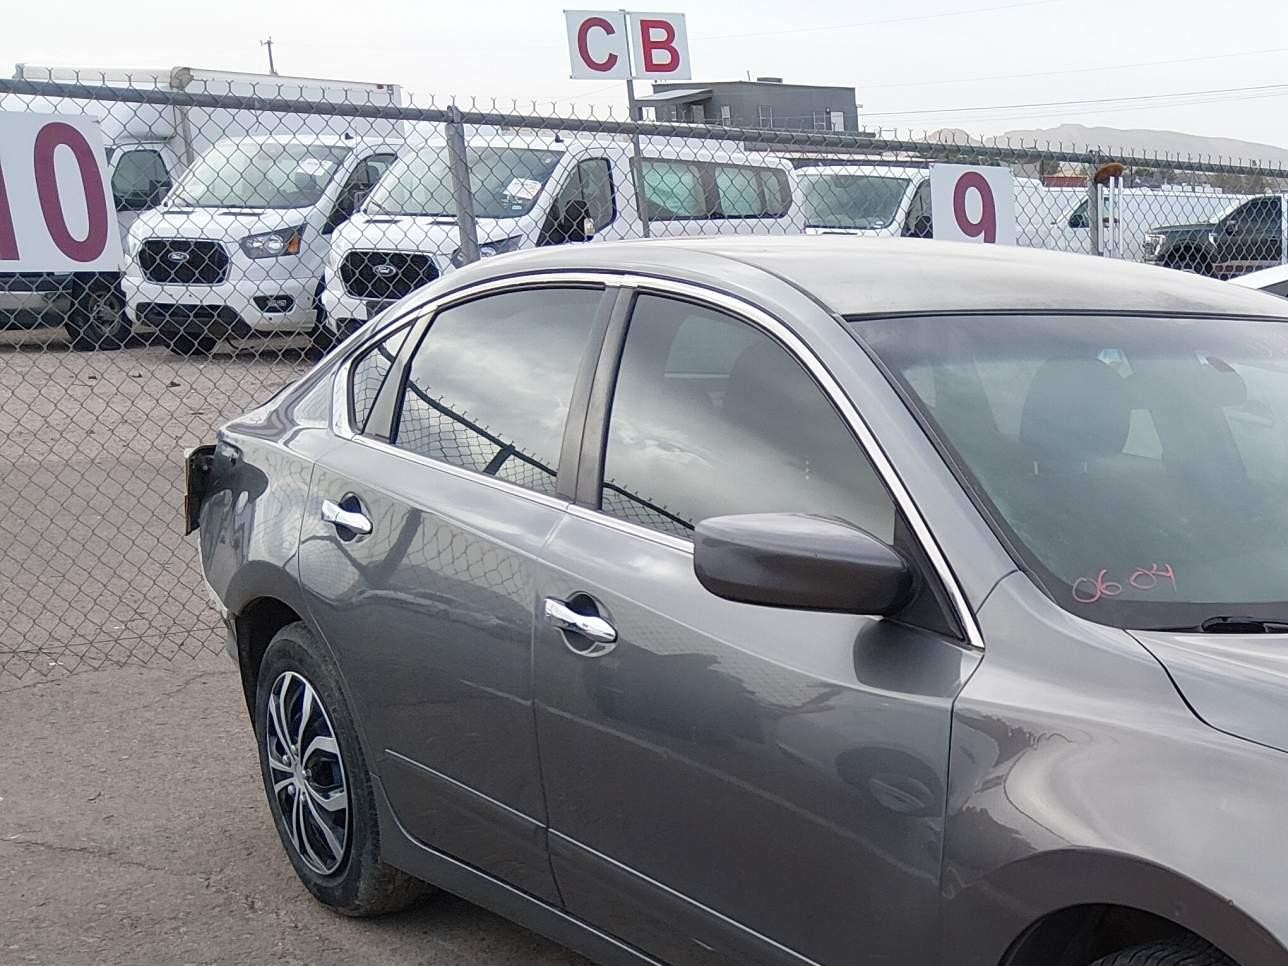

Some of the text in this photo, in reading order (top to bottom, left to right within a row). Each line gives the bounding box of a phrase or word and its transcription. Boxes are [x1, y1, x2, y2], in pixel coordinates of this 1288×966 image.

[577, 17, 618, 72] C
[640, 19, 680, 72] B
[953, 171, 996, 244] 9
[1072, 569, 1122, 603] 06
